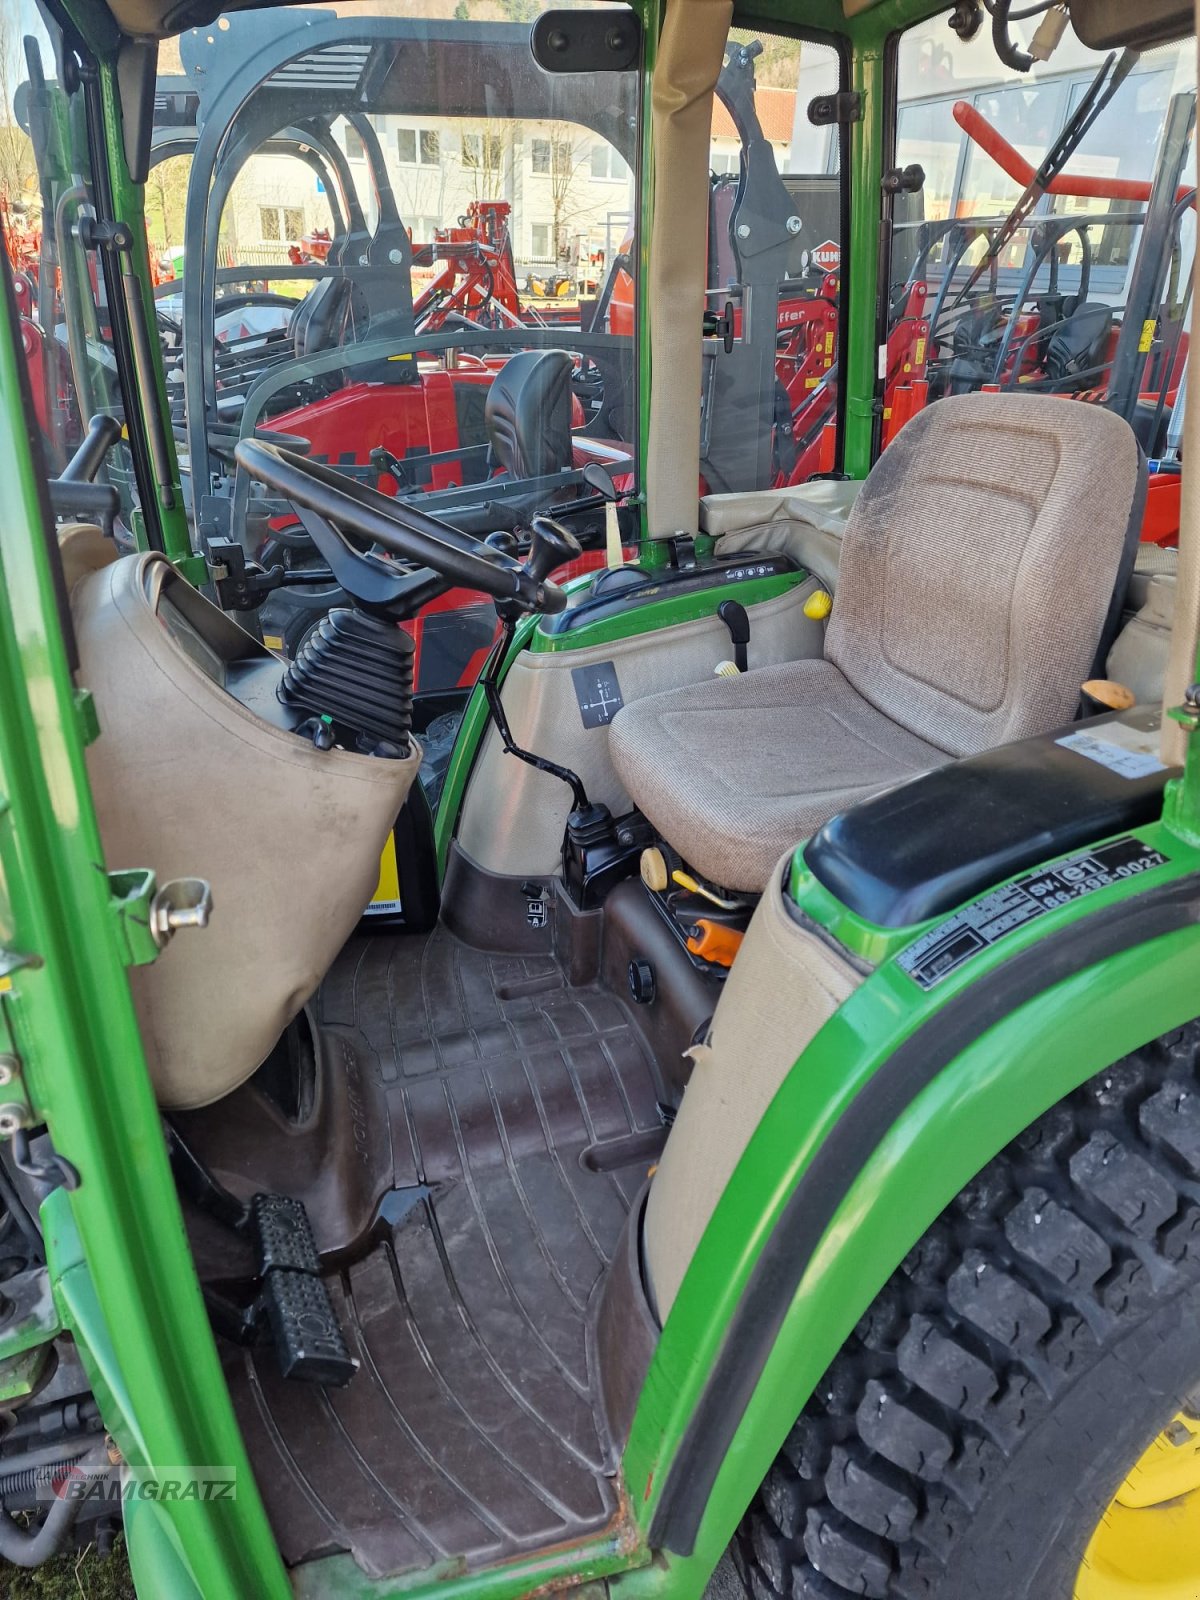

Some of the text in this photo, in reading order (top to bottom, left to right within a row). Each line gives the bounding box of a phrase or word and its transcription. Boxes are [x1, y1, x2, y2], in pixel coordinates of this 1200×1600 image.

[812, 251, 840, 263] KUH
[777, 310, 806, 323] ffer
[1061, 861, 1098, 881] e1
[1043, 853, 1164, 909] 86-298-0027
